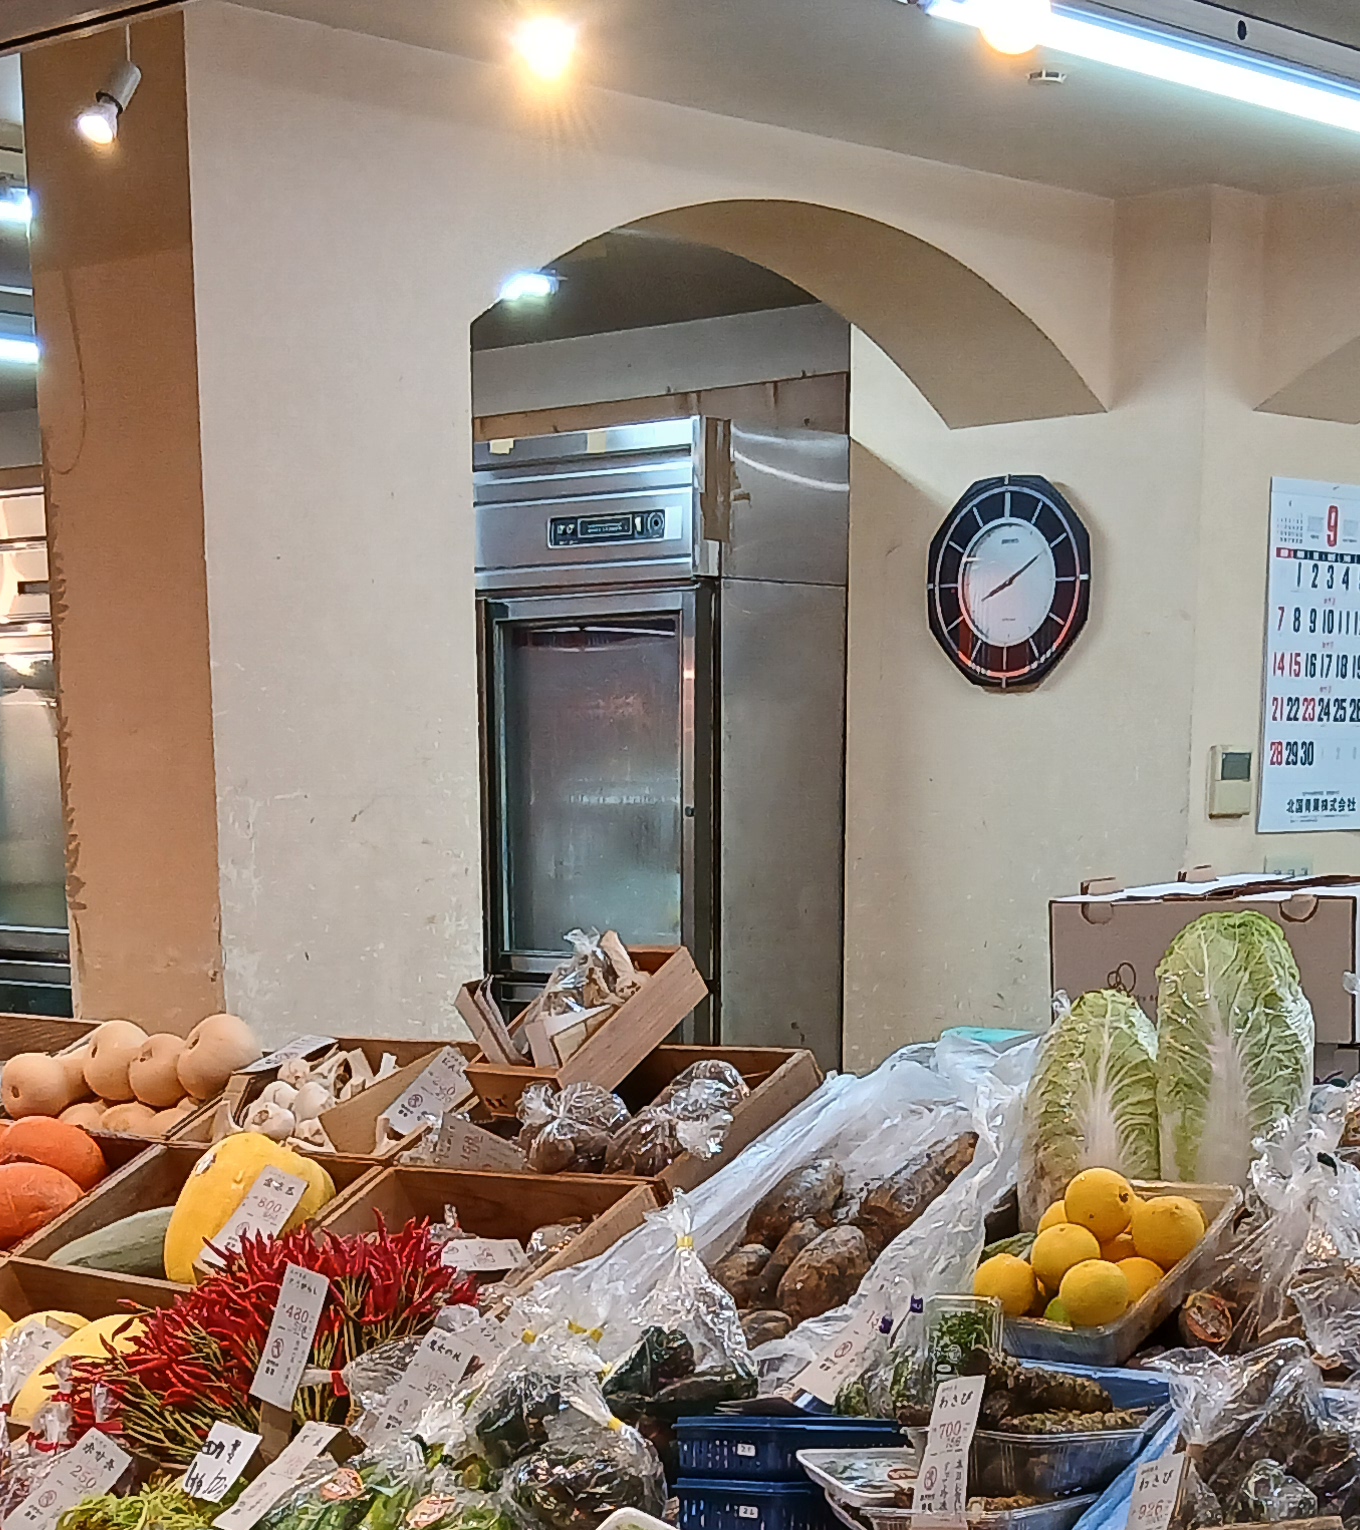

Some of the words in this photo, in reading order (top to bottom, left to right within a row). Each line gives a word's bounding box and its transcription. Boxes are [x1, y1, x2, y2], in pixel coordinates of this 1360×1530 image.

[1327, 505, 1339, 547] 9
[1297, 562, 1302, 588] 1
[1311, 563, 1319, 589] 2
[1327, 565, 1335, 590] 3
[1342, 566, 1350, 591] 4
[1278, 606, 1285, 631] 7
[1293, 607, 1301, 633] 8
[1309, 608, 1317, 633] 9
[1322, 609, 1334, 634] 10
[1338, 610, 1350, 635] 11
[1273, 652, 1285, 677] 14
[1289, 653, 1301, 678] 15
[1305, 653, 1317, 679] 16
[1320, 654, 1333, 679] 17
[1336, 654, 1348, 679] 18
[1272, 697, 1284, 721] 21
[1286, 697, 1300, 721] 22
[1302, 697, 1316, 722] 23
[1317, 698, 1331, 722] 24
[1333, 698, 1347, 722] 25
[1270, 741, 1283, 766] 28
[1285, 741, 1298, 766] 29
[1300, 741, 1314, 767] 30
[286, 1305, 309, 1323] 480
[940, 1391, 973, 1409] わさび
[940, 1420, 962, 1438] 700
[70, 1465, 97, 1488] 250
[1139, 1469, 1174, 1491] わさび
